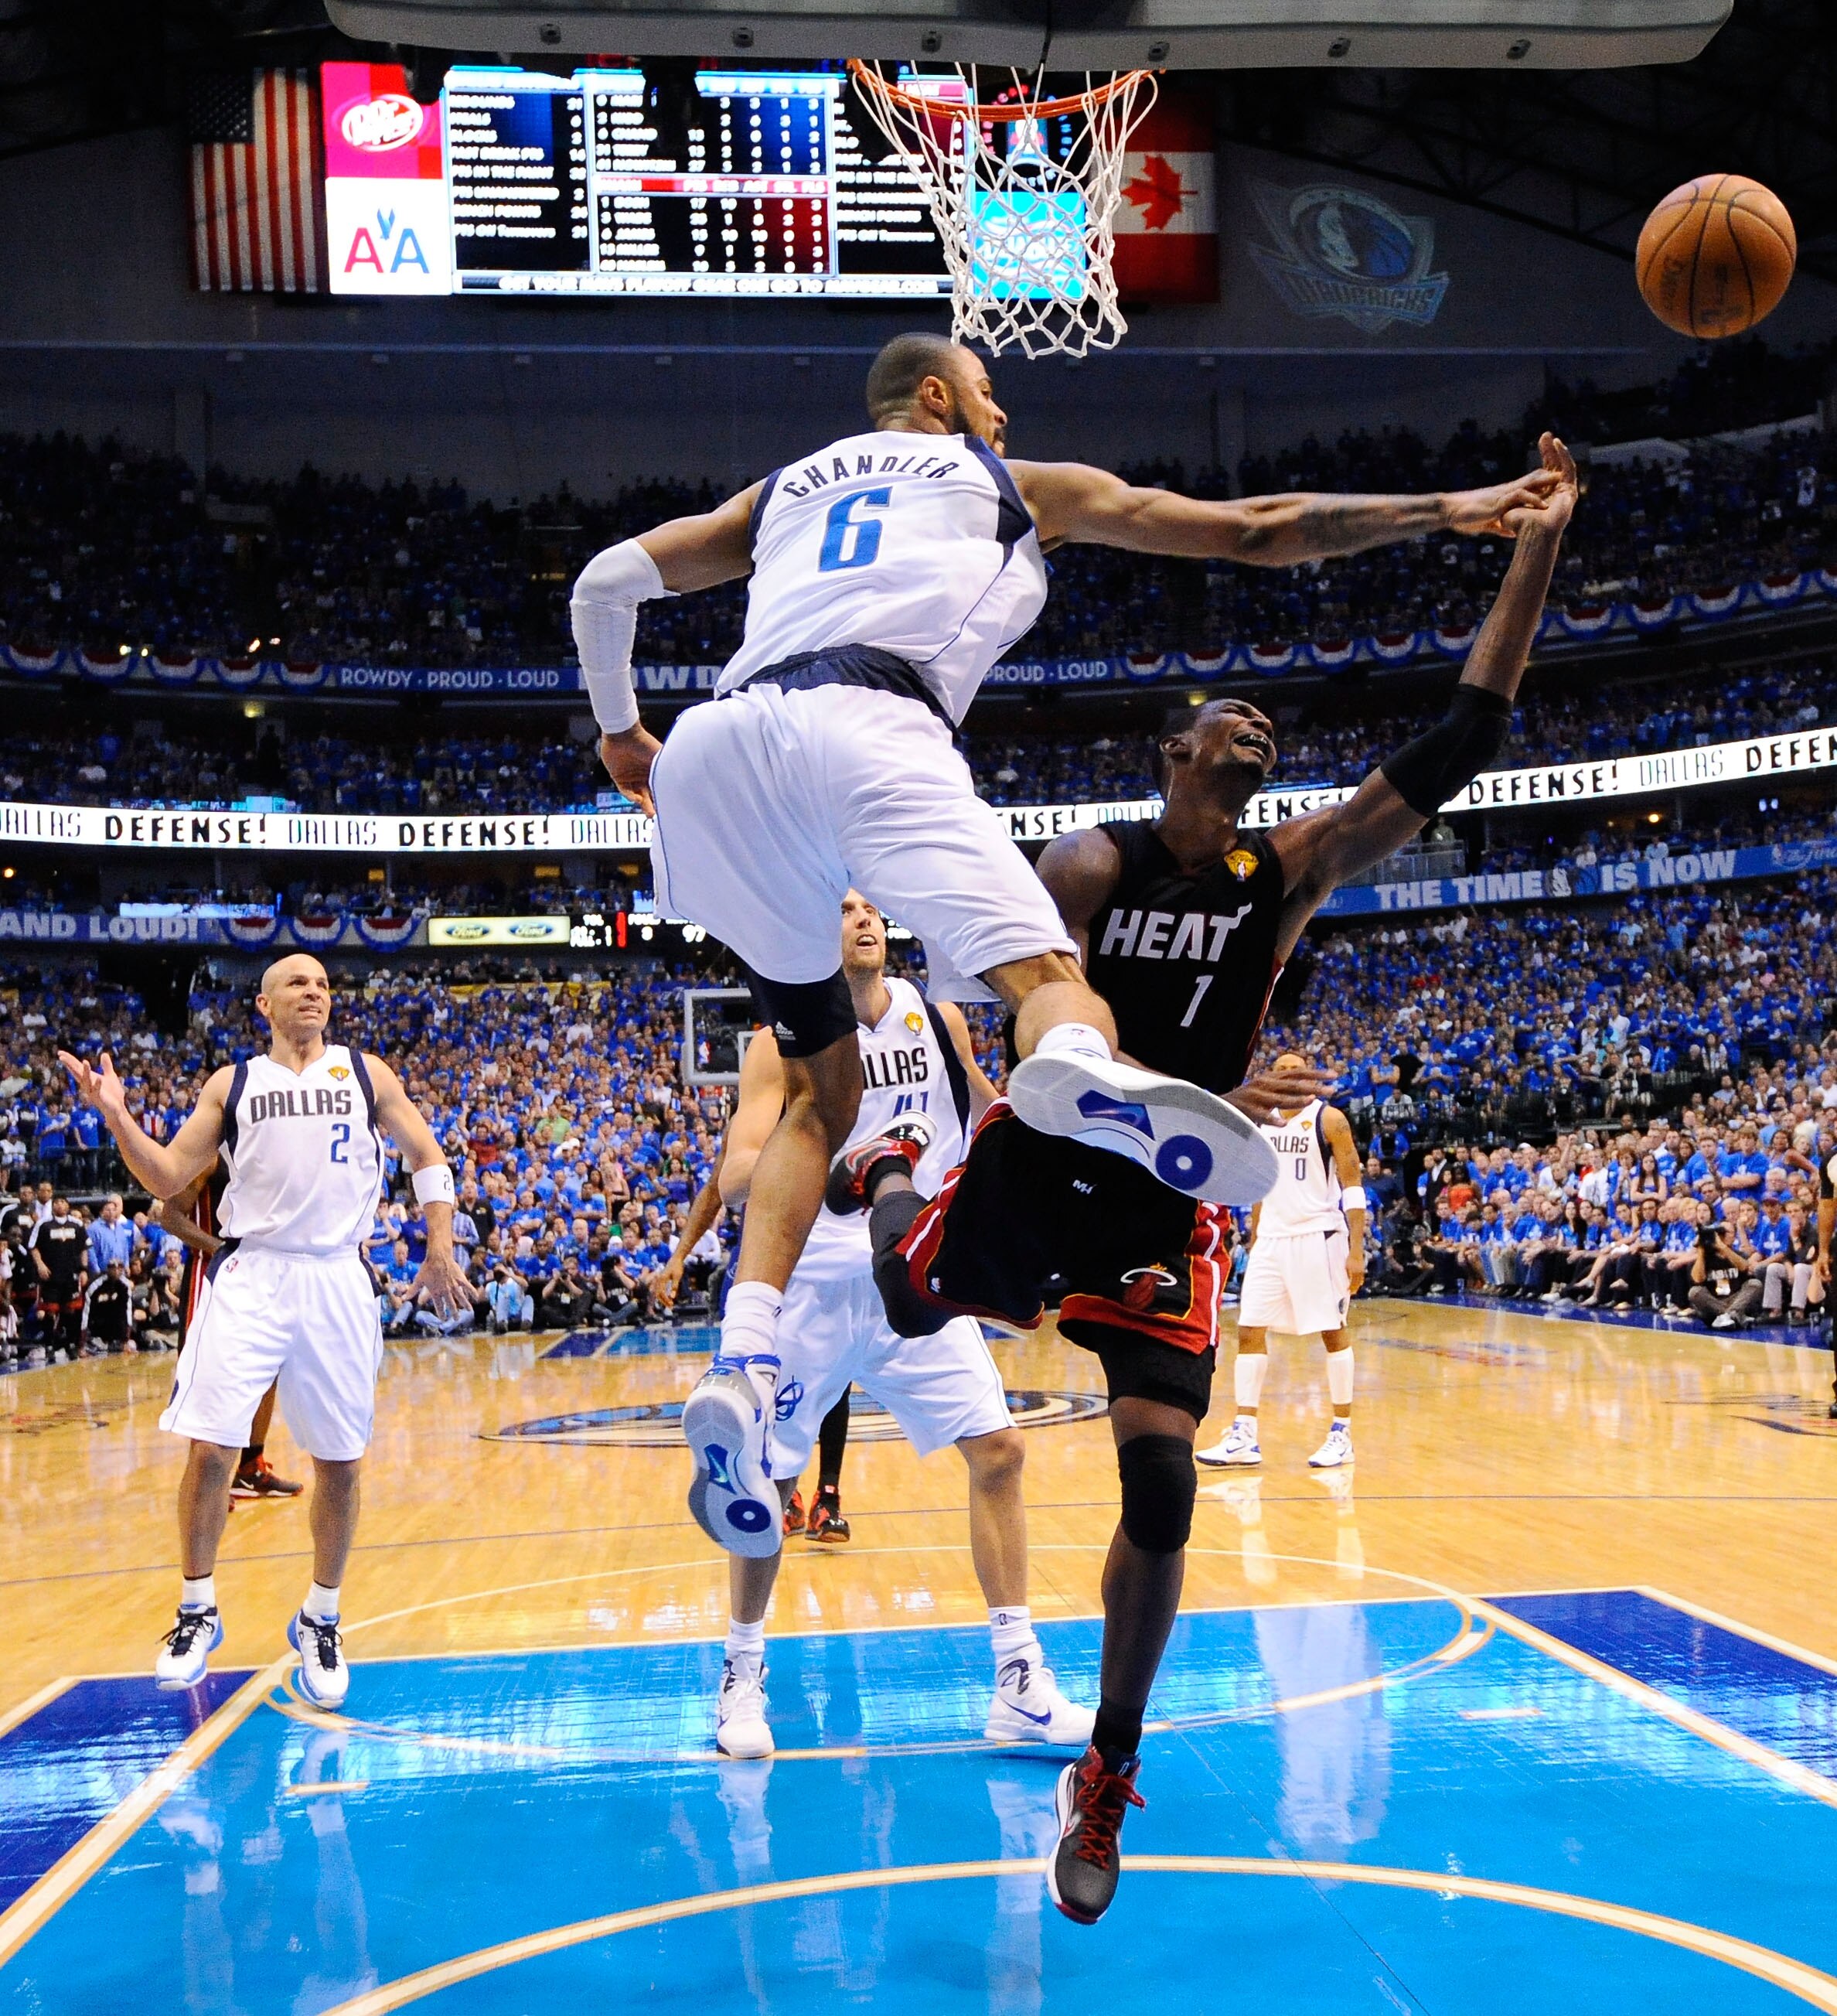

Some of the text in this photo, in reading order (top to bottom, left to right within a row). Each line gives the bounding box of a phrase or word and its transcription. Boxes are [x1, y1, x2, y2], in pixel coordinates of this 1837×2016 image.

[782, 454, 960, 498] CHANDLER
[816, 485, 893, 573] 6
[341, 667, 561, 688] ROWDY PROUD LOUD
[983, 660, 1108, 682] PROUD LOUD
[1469, 760, 1617, 804] DEFENSE!
[1640, 749, 1723, 786] DALLAS
[0, 808, 81, 837] ALLAS
[105, 813, 266, 844] DEFENSE!
[288, 818, 377, 845] DALLAS
[399, 816, 550, 847] DEFENSE!
[1374, 848, 1736, 911] THE TIME IS NOW
[0, 912, 199, 940] AND LOUD!
[1099, 902, 1252, 962] HEAT
[1180, 974, 1215, 1028] 1
[250, 1088, 352, 1124] DALLAS
[330, 1122, 351, 1165] 2
[443, 1174, 452, 1191] 2
[1295, 1158, 1307, 1181] 0
